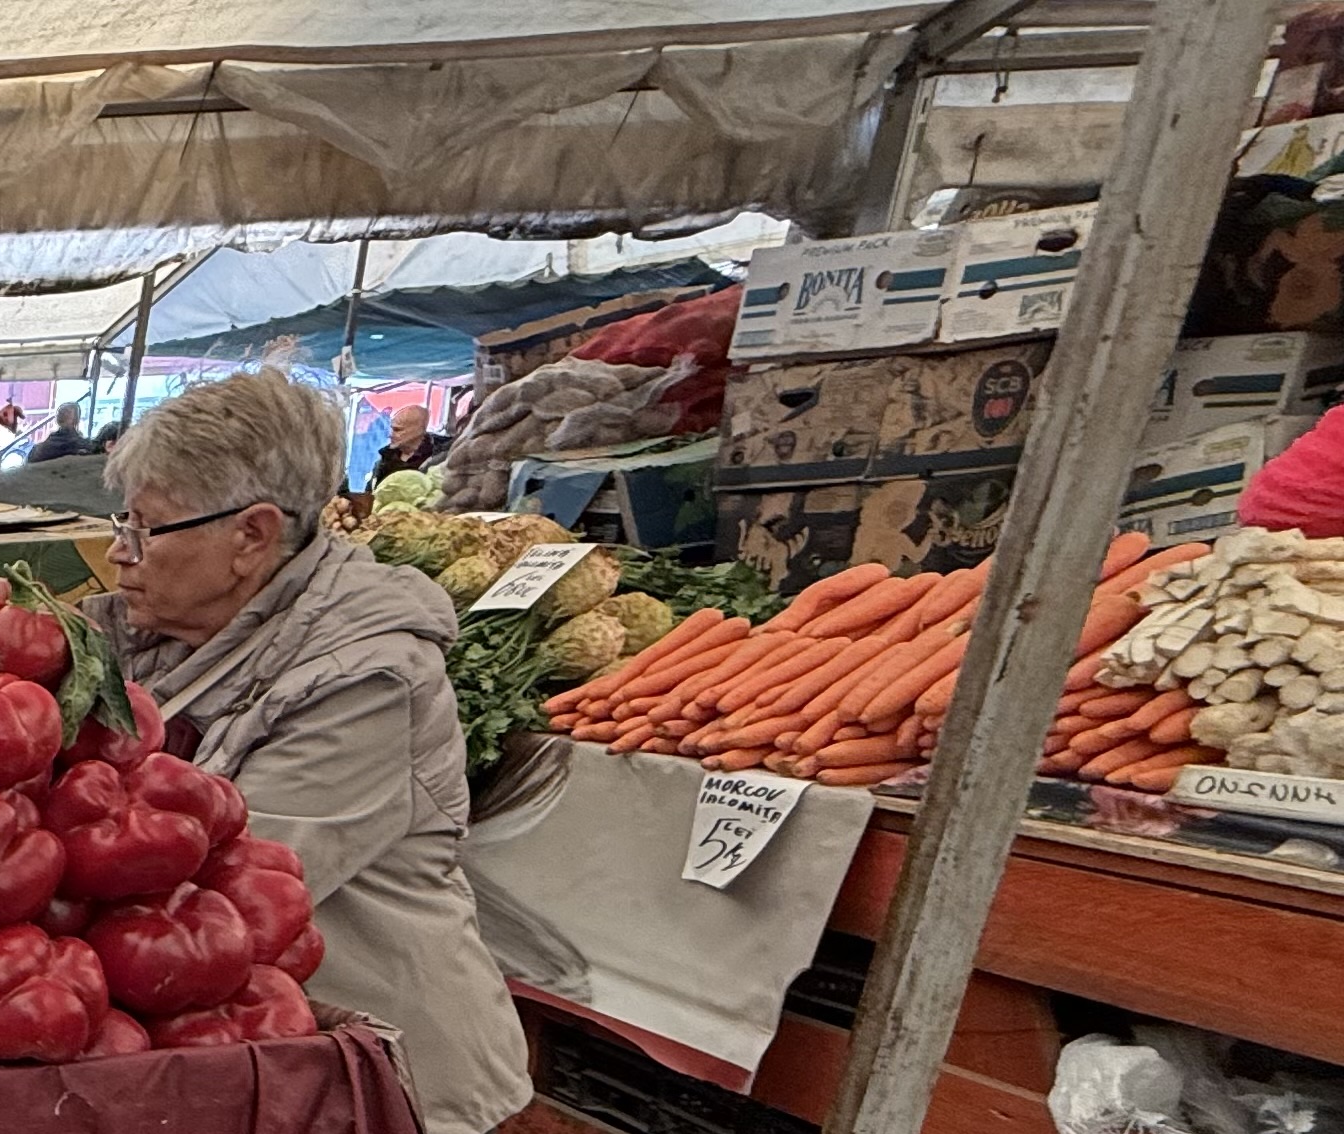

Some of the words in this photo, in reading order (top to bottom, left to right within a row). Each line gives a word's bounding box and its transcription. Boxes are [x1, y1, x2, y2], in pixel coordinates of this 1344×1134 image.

[793, 266, 864, 310] BONITA
[704, 777, 787, 802] MORCOV
[693, 818, 742, 870] 5
